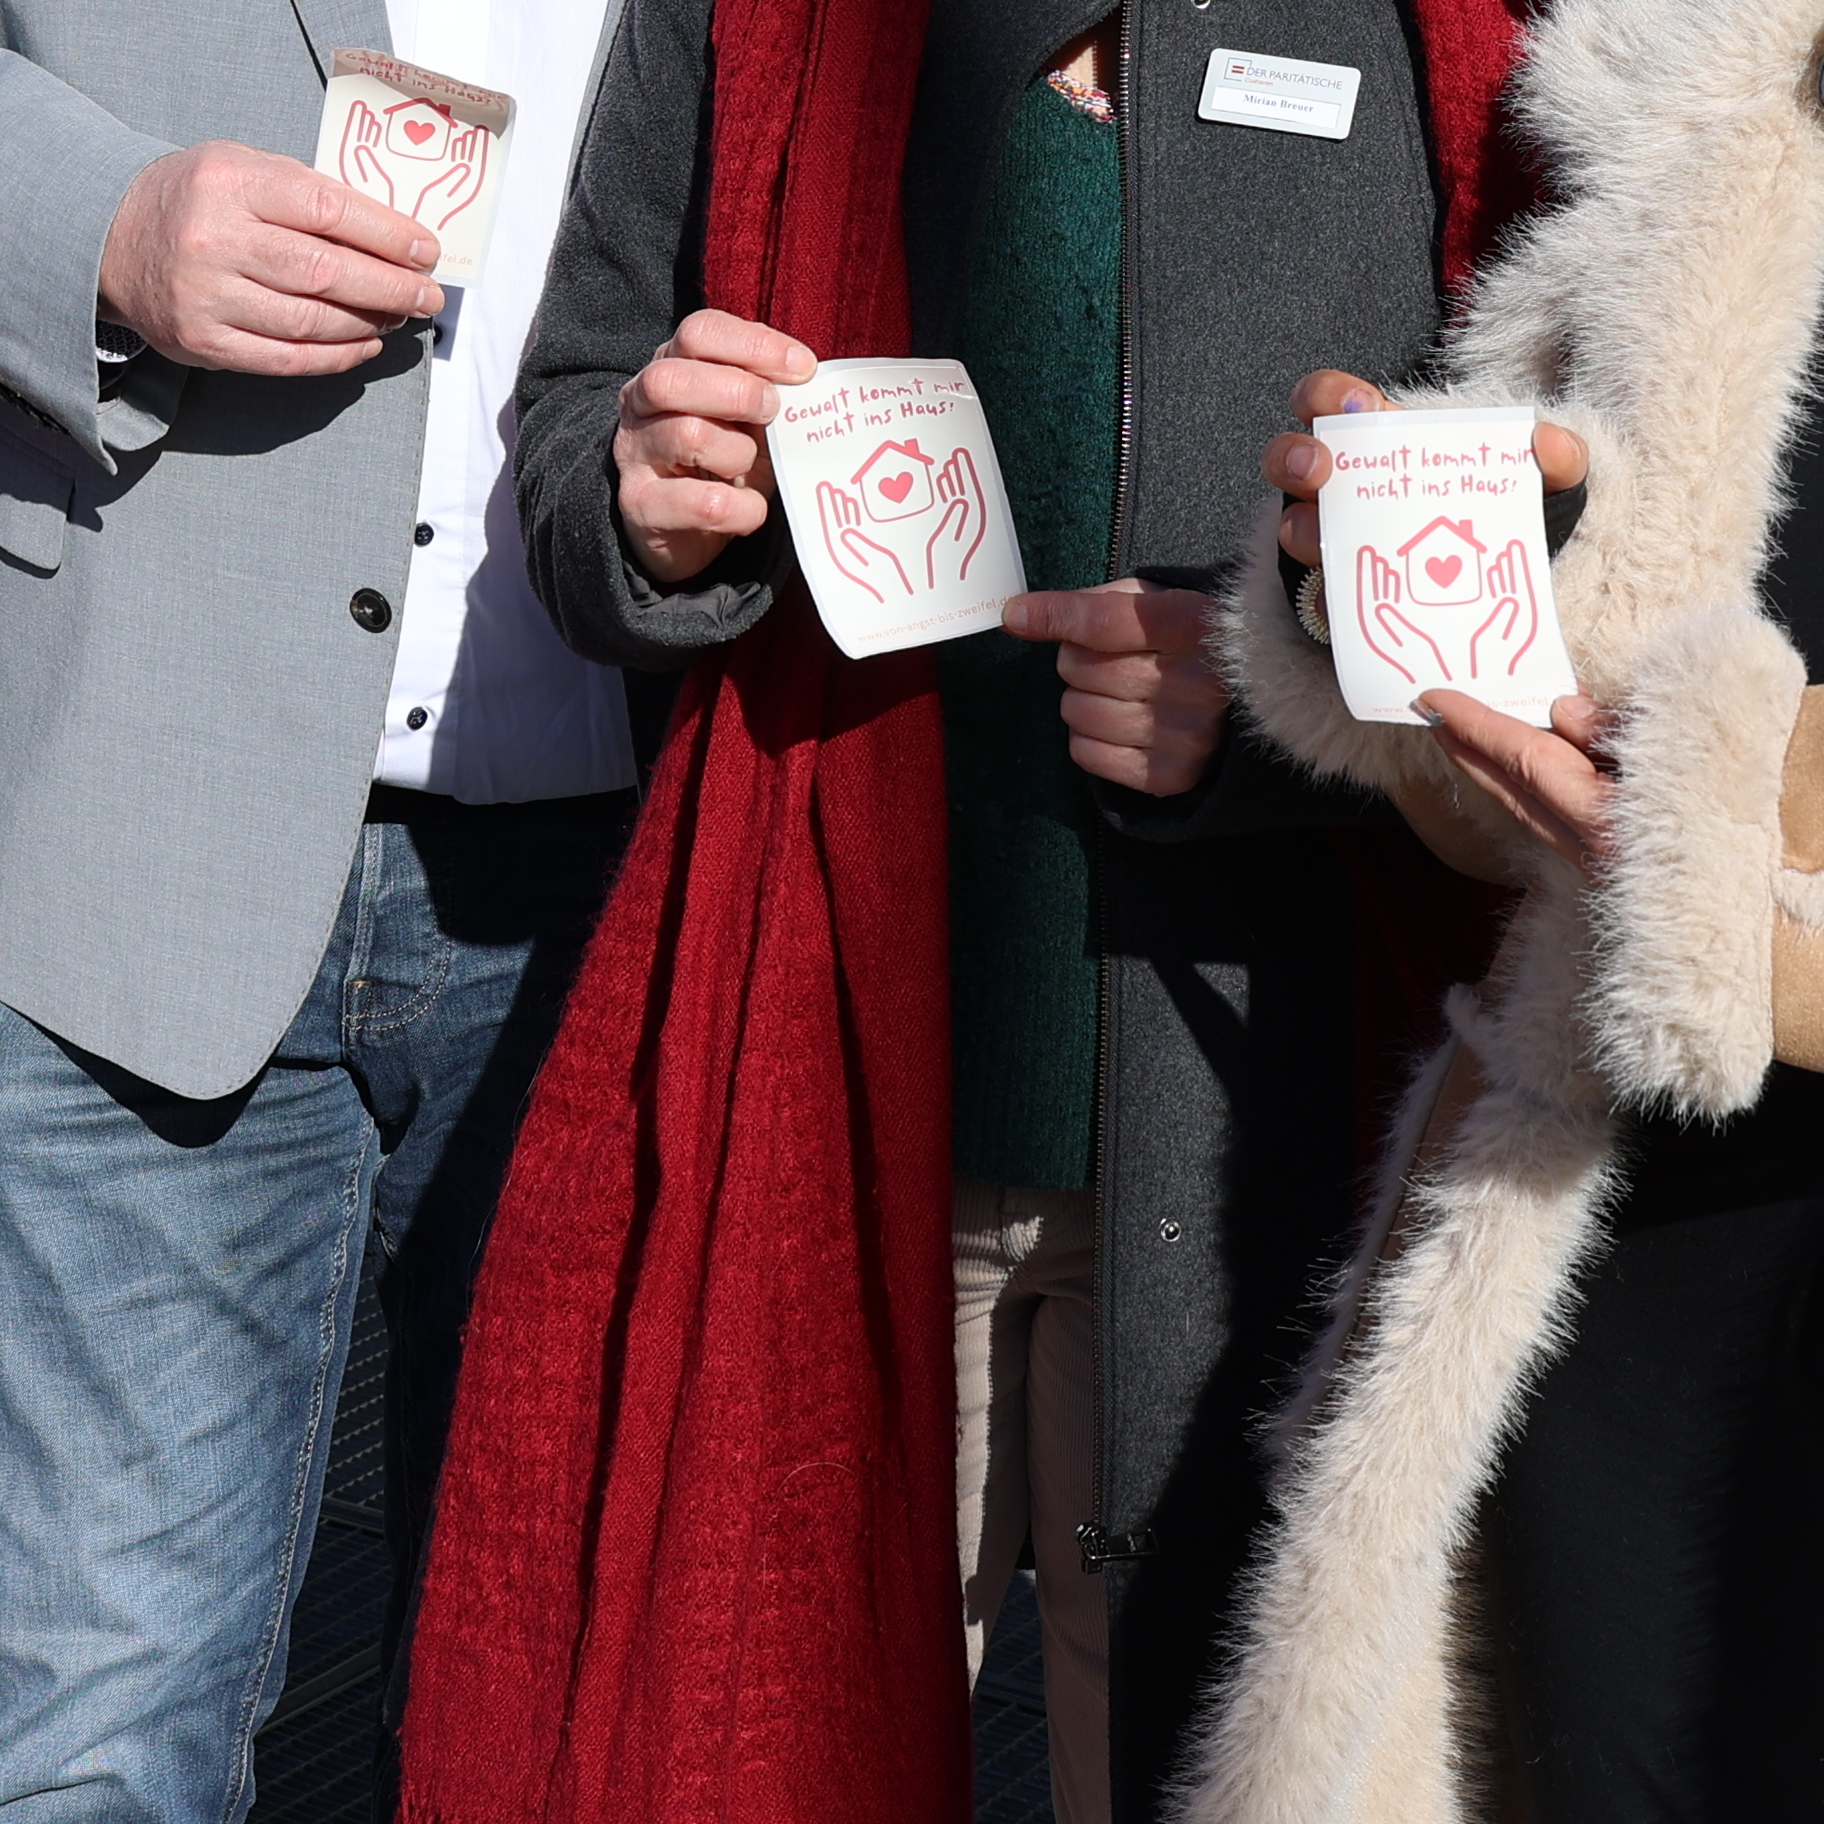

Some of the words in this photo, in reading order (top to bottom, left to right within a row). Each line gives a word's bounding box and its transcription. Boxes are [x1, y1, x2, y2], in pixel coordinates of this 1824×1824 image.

[1246, 66, 1267, 80] DER
[1268, 70, 1343, 90] PARITÄTISCHE
[1280, 99, 1314, 113] Breuer
[784, 387, 850, 423] Gewalt
[859, 377, 924, 403] kommt
[933, 380, 964, 394] mir
[806, 411, 855, 443] nicht
[864, 408, 893, 427] ins
[899, 401, 955, 419] Haus!
[1335, 444, 1412, 472] Gewalt
[1421, 441, 1492, 468] kommt
[1500, 447, 1536, 465] mir
[1356, 472, 1413, 501] nicht
[1422, 479, 1452, 496] ins
[1460, 474, 1517, 495] Haus!
